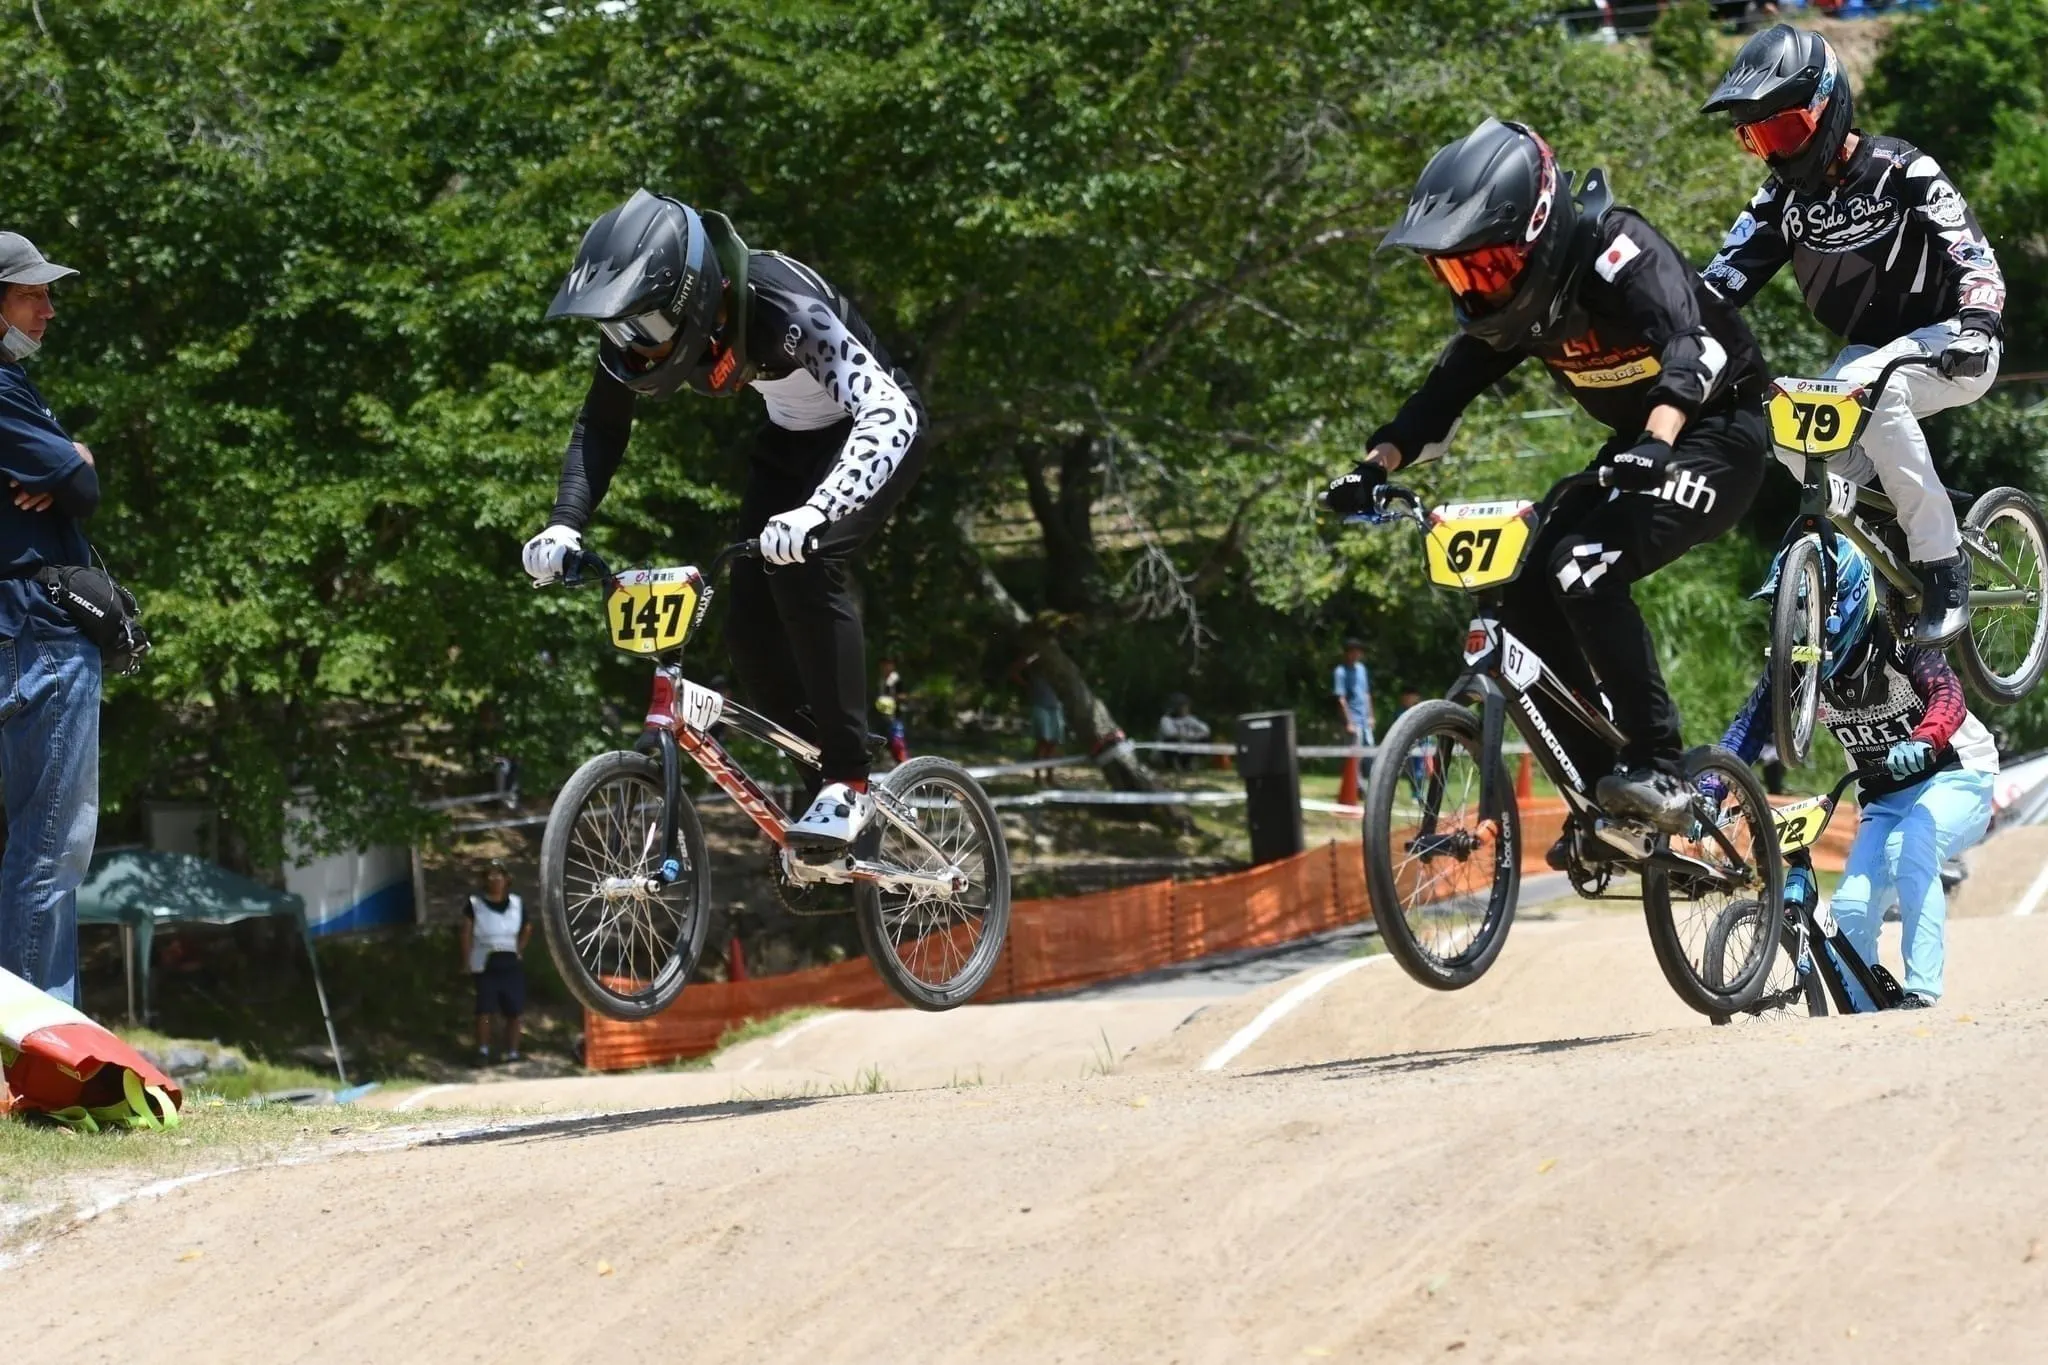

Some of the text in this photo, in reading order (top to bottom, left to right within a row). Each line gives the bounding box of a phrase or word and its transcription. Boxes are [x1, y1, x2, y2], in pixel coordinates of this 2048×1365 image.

[1786, 197, 1892, 238] B Side Bikes
[672, 274, 694, 315] SMITH
[1793, 403, 1840, 441] 79
[1447, 528, 1503, 574] 67
[618, 594, 685, 641] 147
[1508, 644, 1524, 675] 67
[1519, 693, 1587, 793] MONGOOSE
[1775, 816, 1807, 844] 72
[1501, 840, 1512, 868] box
